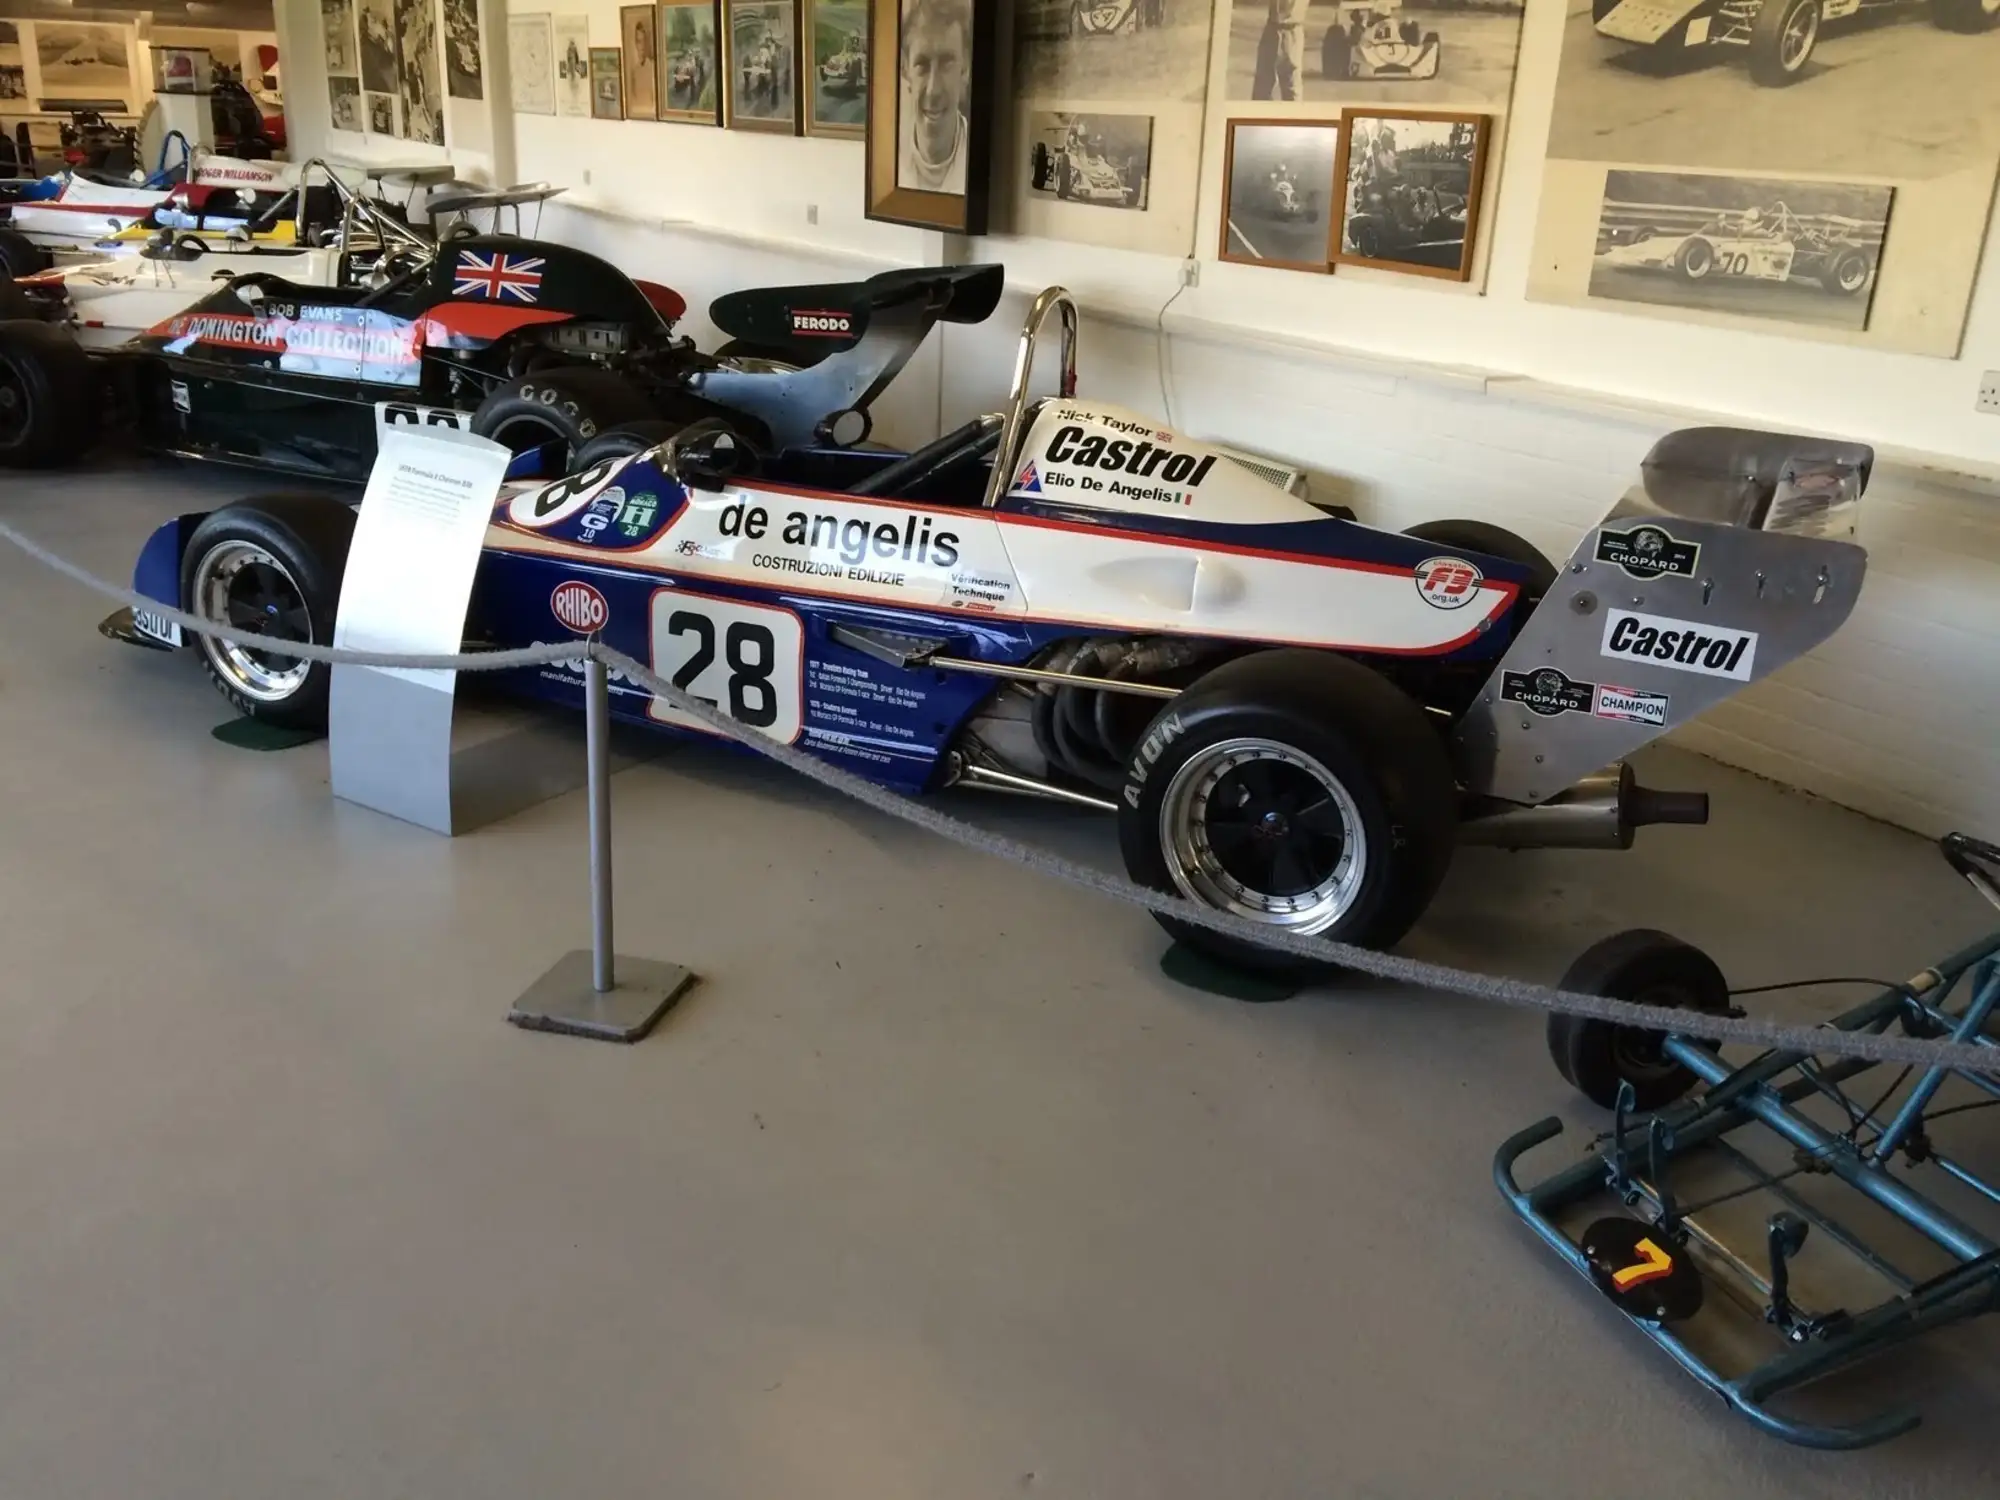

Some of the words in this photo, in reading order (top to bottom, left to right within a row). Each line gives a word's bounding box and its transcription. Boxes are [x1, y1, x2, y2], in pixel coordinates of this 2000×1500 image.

[223, 169, 273, 182] WILLIAMSON
[1720, 251, 1749, 276] 70
[268, 304, 294, 317] BOB
[300, 305, 343, 321] EVANS
[793, 316, 849, 331] FERODO
[187, 317, 278, 347] DONINGTON
[286, 326, 408, 362] COLLECTION
[1057, 408, 1093, 425] Nick
[1101, 415, 1153, 437] Taylor
[1045, 425, 1218, 487] Castrol
[1044, 472, 1075, 487] Elio
[1081, 476, 1103, 491] De
[1108, 482, 1172, 503] Angelis
[581, 513, 609, 531] G
[620, 505, 656, 527] H
[582, 529, 596, 538] 10
[624, 525, 639, 537] 28
[718, 494, 769, 540] de
[782, 510, 959, 567] angelis
[752, 553, 843, 579] COSTRUZIONI
[848, 567, 904, 587] EDILIZIE
[1610, 552, 1679, 571] CHOPARD
[1423, 567, 1474, 594] F3
[953, 586, 1005, 602] Technique
[555, 588, 603, 628] RHIBO
[1608, 616, 1750, 672] Castrol
[668, 610, 777, 728] 28
[1515, 691, 1578, 708] CHOPARD
[1601, 696, 1664, 716] CHAMPION
[1124, 713, 1185, 809] AVON
[1612, 1236, 1673, 1293] 7
